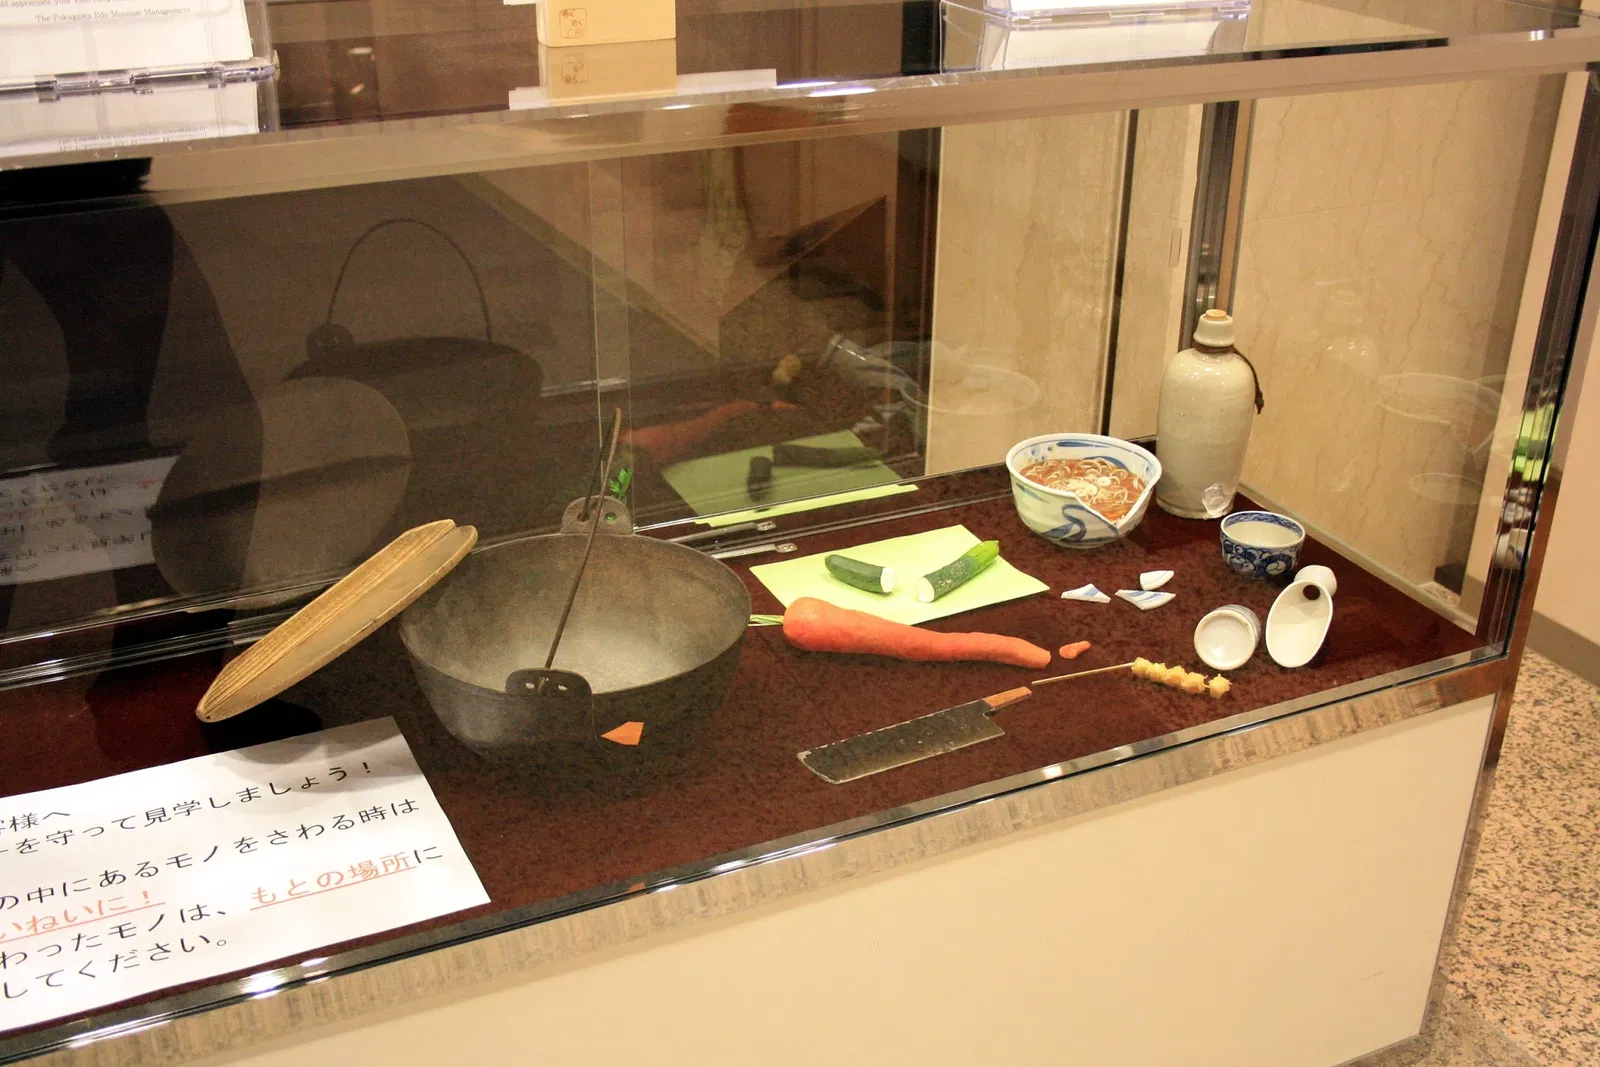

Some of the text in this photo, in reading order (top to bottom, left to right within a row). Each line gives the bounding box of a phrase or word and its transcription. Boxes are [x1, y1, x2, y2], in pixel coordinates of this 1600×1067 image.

[36, 14, 52, 22] The
[94, 11, 109, 19] Edo
[110, 9, 143, 18] Museum
[144, 7, 191, 16] Management
[0, 812, 71, 835] 様へ
[0, 799, 420, 911] の中にあるモノをさわる時は
[4, 934, 228, 999] してください。
